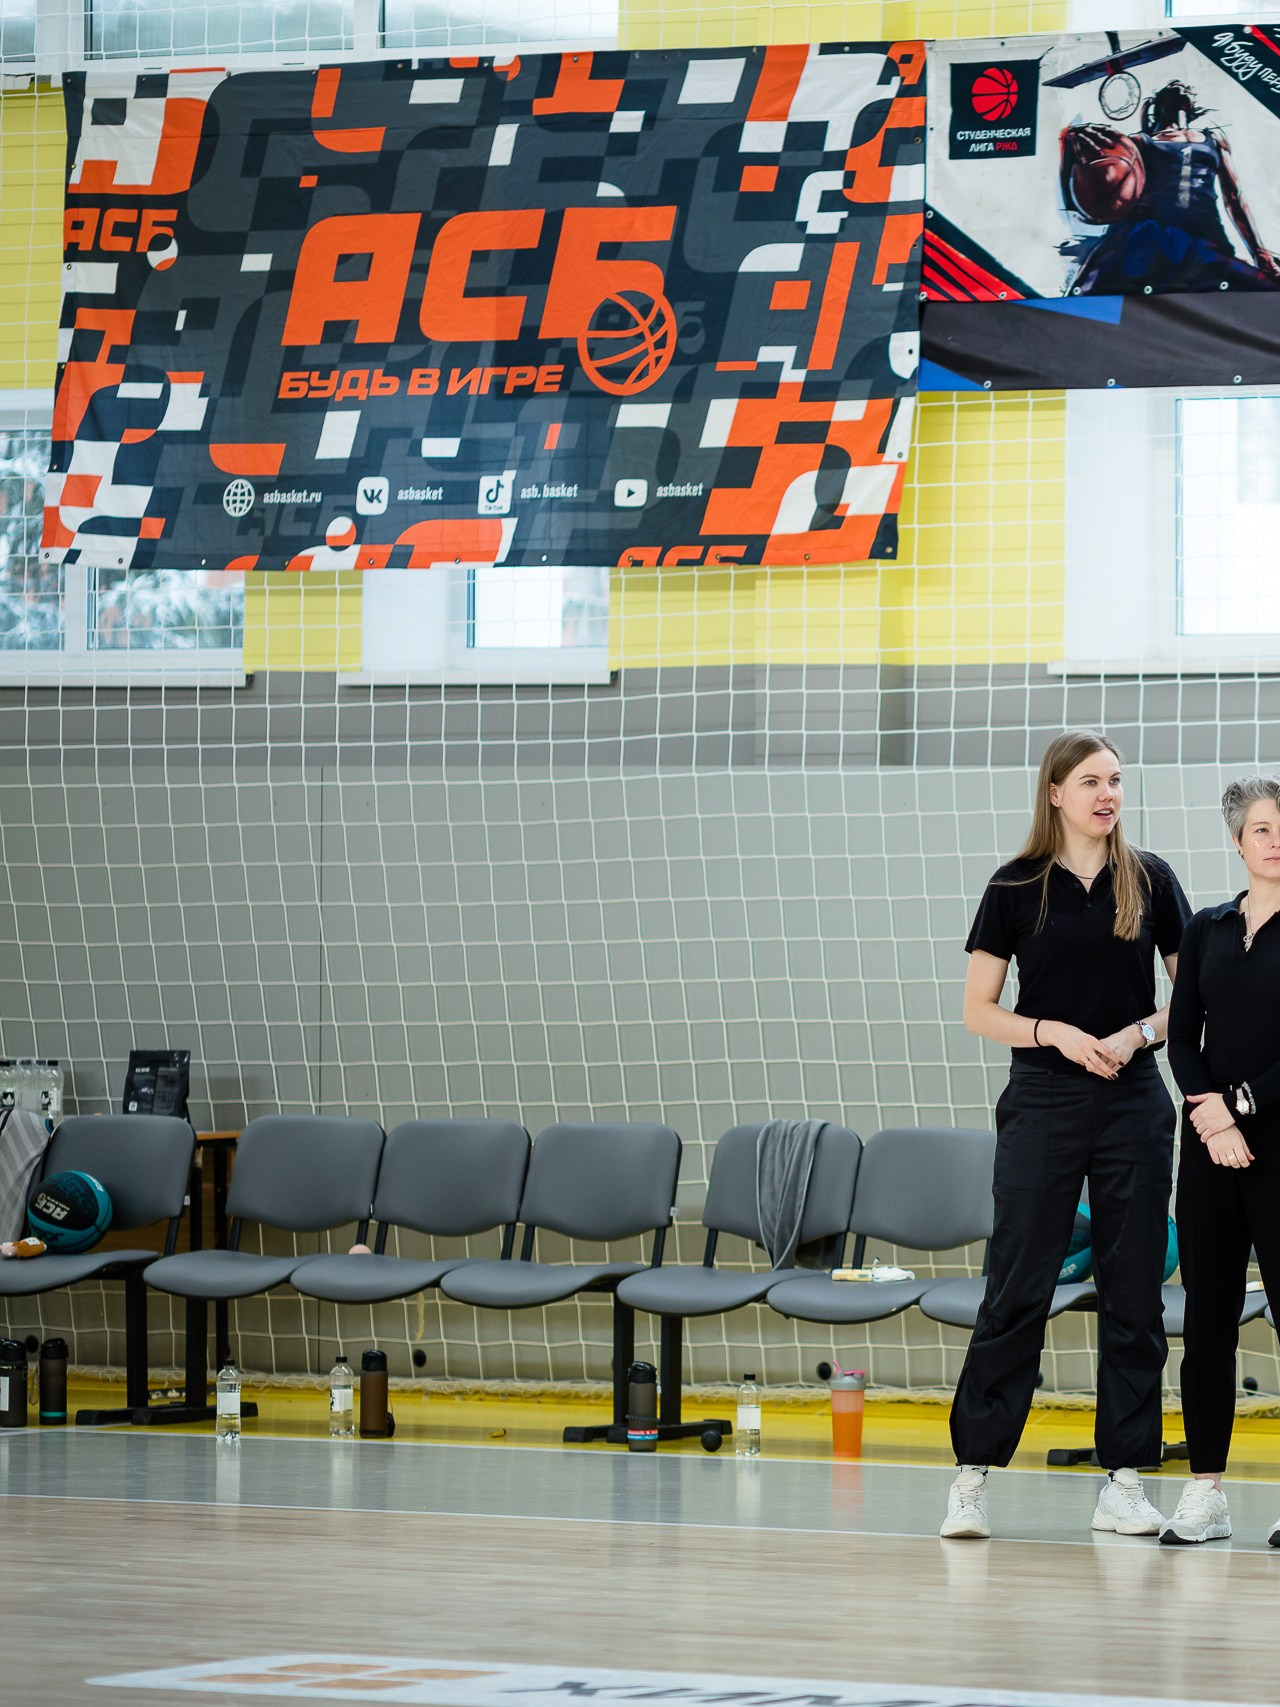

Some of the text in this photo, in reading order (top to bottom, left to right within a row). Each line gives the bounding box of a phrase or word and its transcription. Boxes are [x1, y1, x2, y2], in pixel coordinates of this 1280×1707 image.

[956, 127, 1031, 141] СТУДЕНЧЕСКАЯ
[968, 141, 1018, 152] ЛИГА РЖД
[281, 206, 678, 395] АСБ
[278, 364, 565, 401] БУДЬ В ИГРЕ
[263, 488, 322, 504] asbasket.ru
[397, 485, 444, 500] asbasket
[656, 481, 704, 498] asbasket
